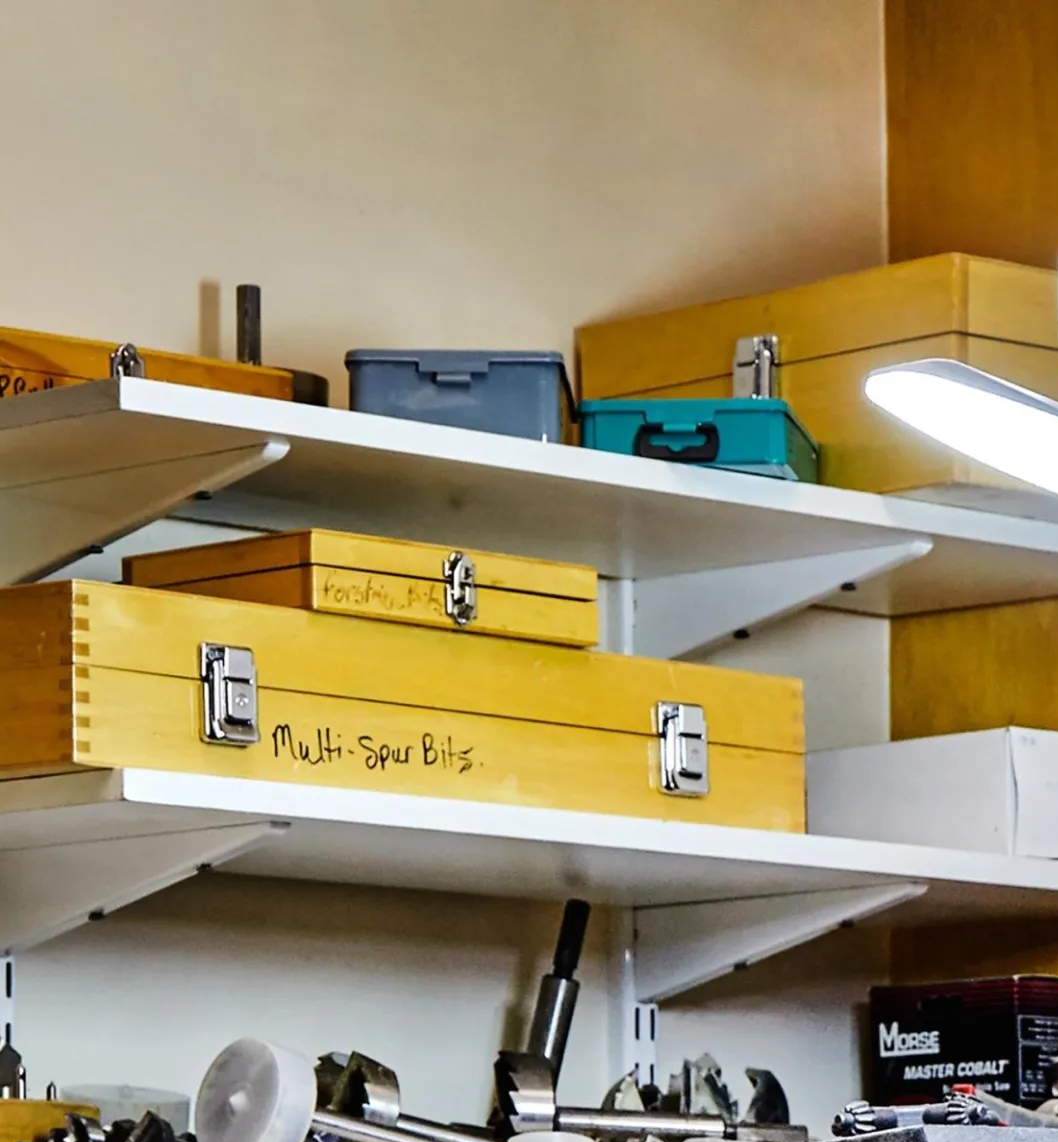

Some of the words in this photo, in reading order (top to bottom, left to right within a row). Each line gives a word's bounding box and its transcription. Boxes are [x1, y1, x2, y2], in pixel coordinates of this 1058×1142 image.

[271, 723, 414, 771] Multi-Spur
[903, 1063, 955, 1080] MASTER
[957, 1060, 1010, 1077] COBALT
